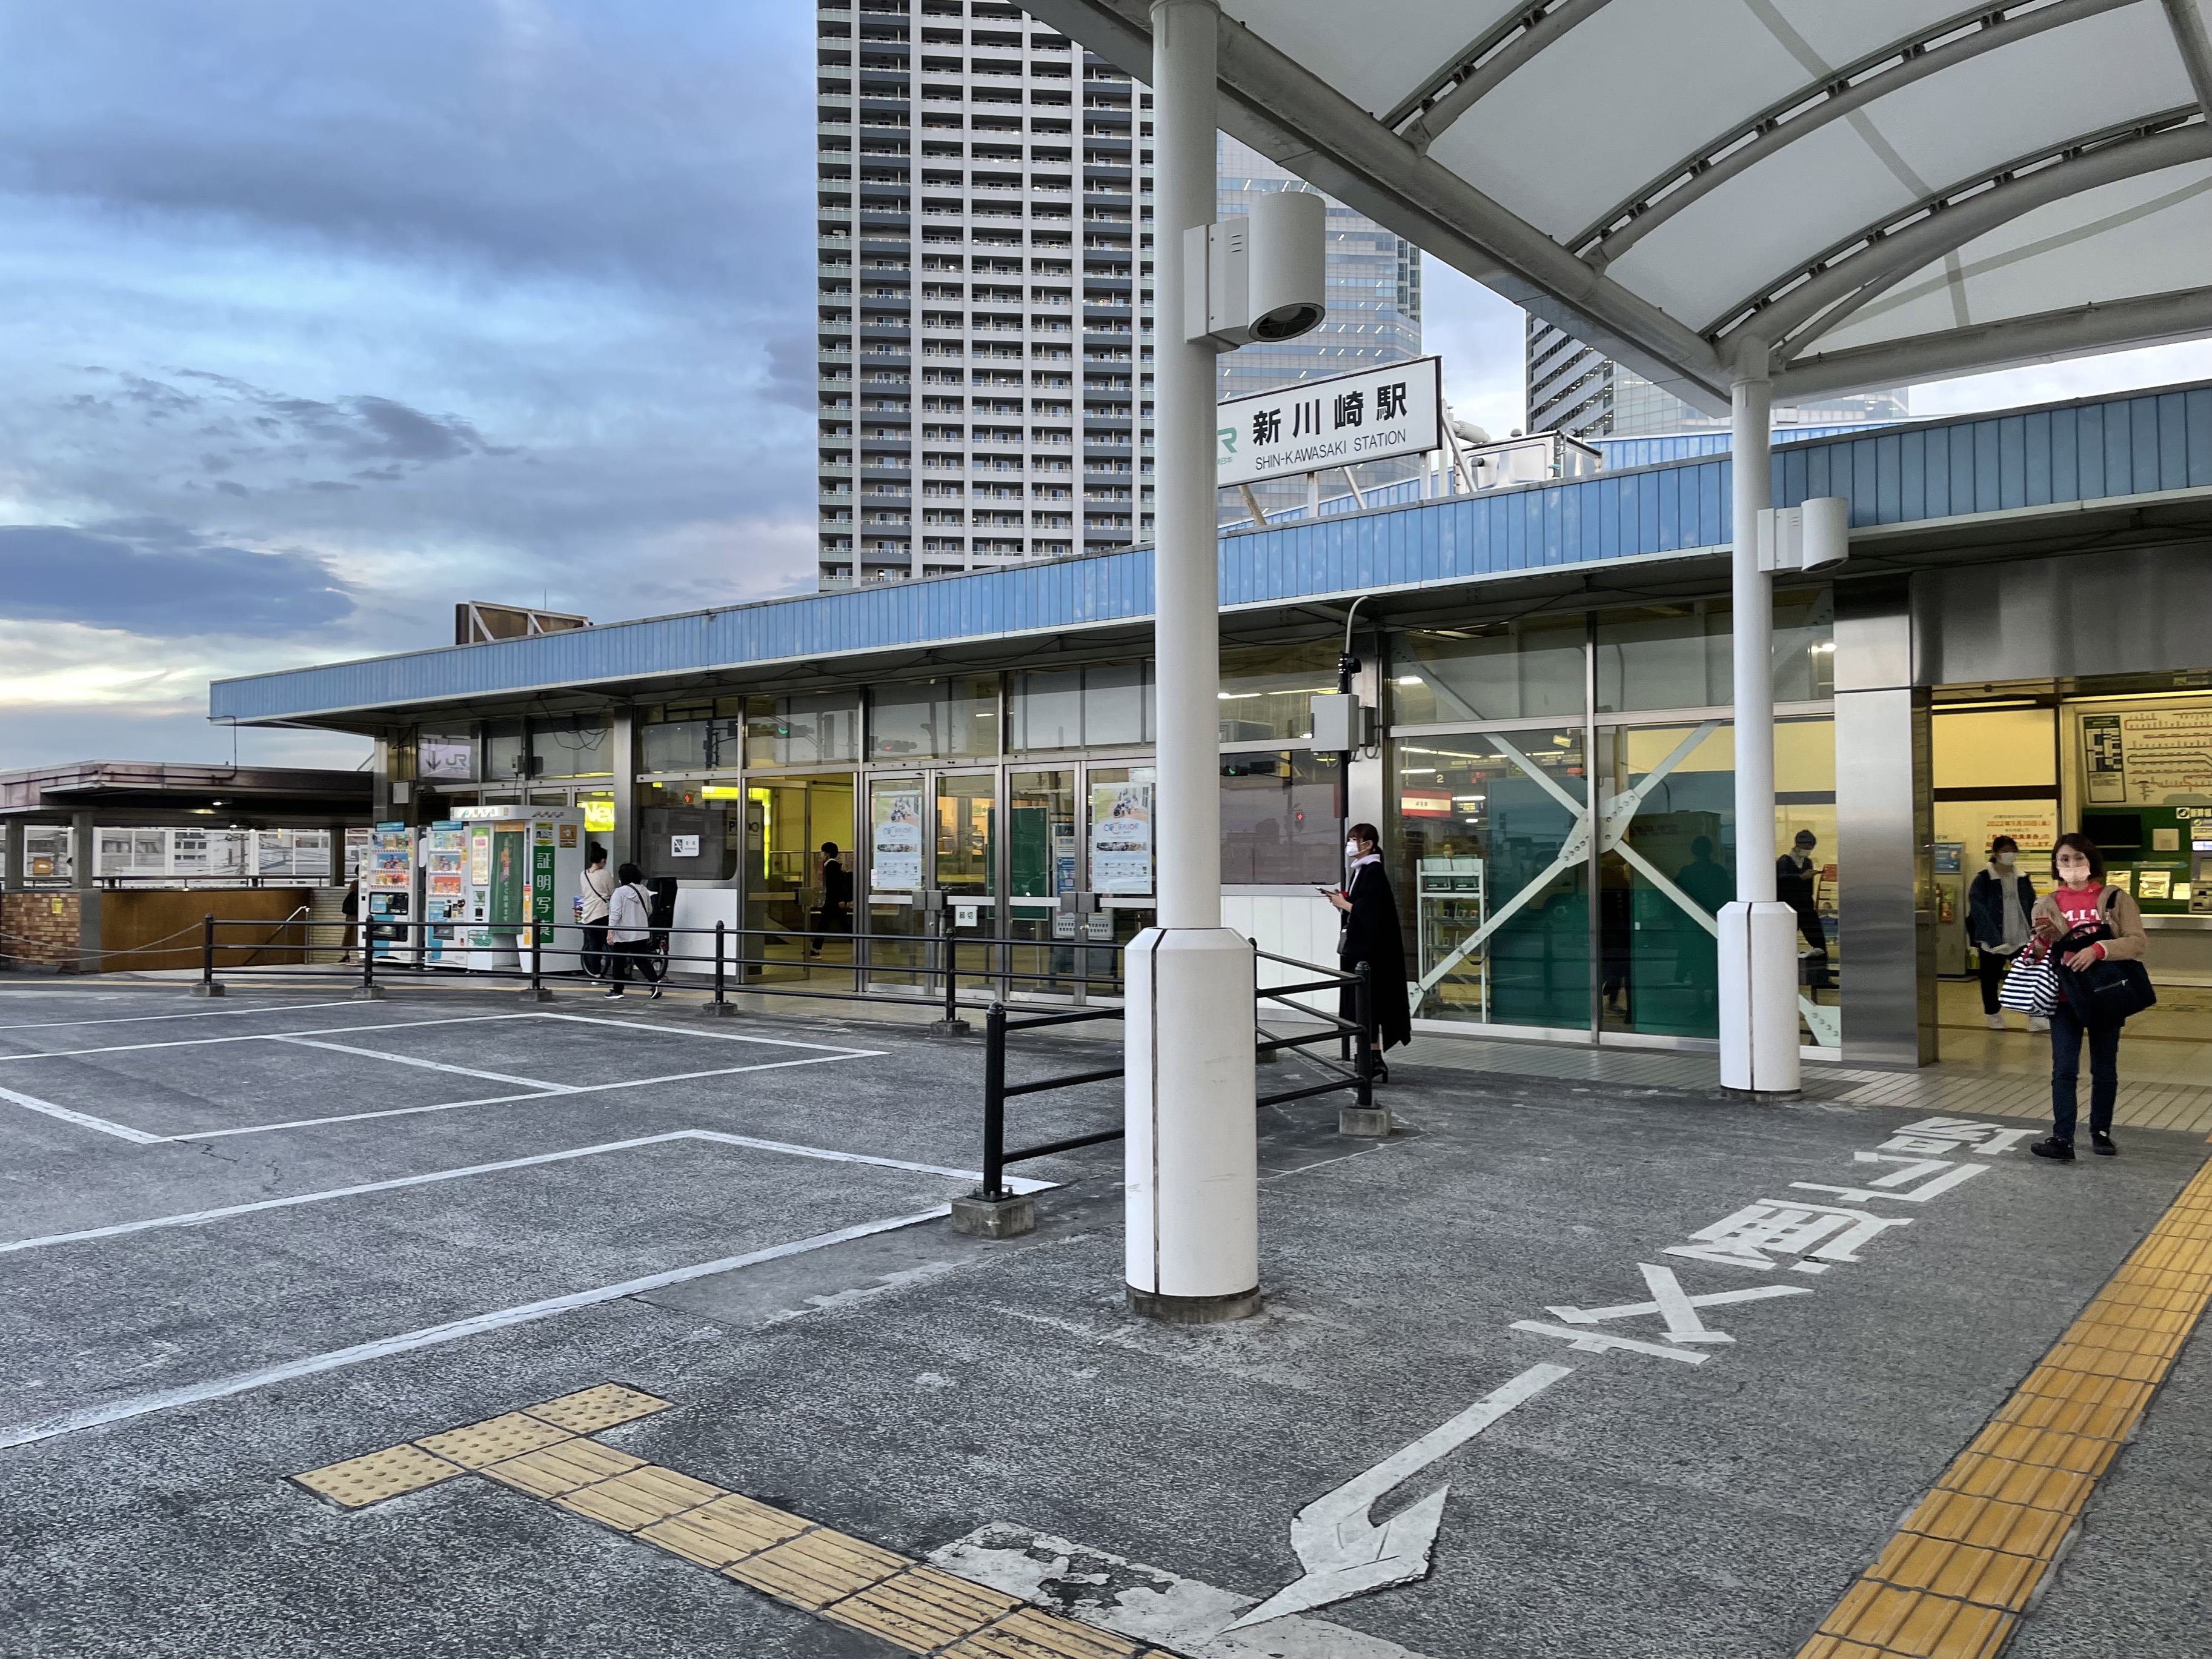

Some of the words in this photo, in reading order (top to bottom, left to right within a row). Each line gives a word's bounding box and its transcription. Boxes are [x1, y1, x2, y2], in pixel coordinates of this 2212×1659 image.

[1253, 382, 1407, 446] 新川崎駅
[1217, 427, 1238, 453] R
[1255, 440, 1346, 470] SHIN-KAWASAKI
[1353, 428, 1406, 451] STATION
[445, 754, 467, 766] JR
[1507, 1116, 2044, 1365] 交通広場
